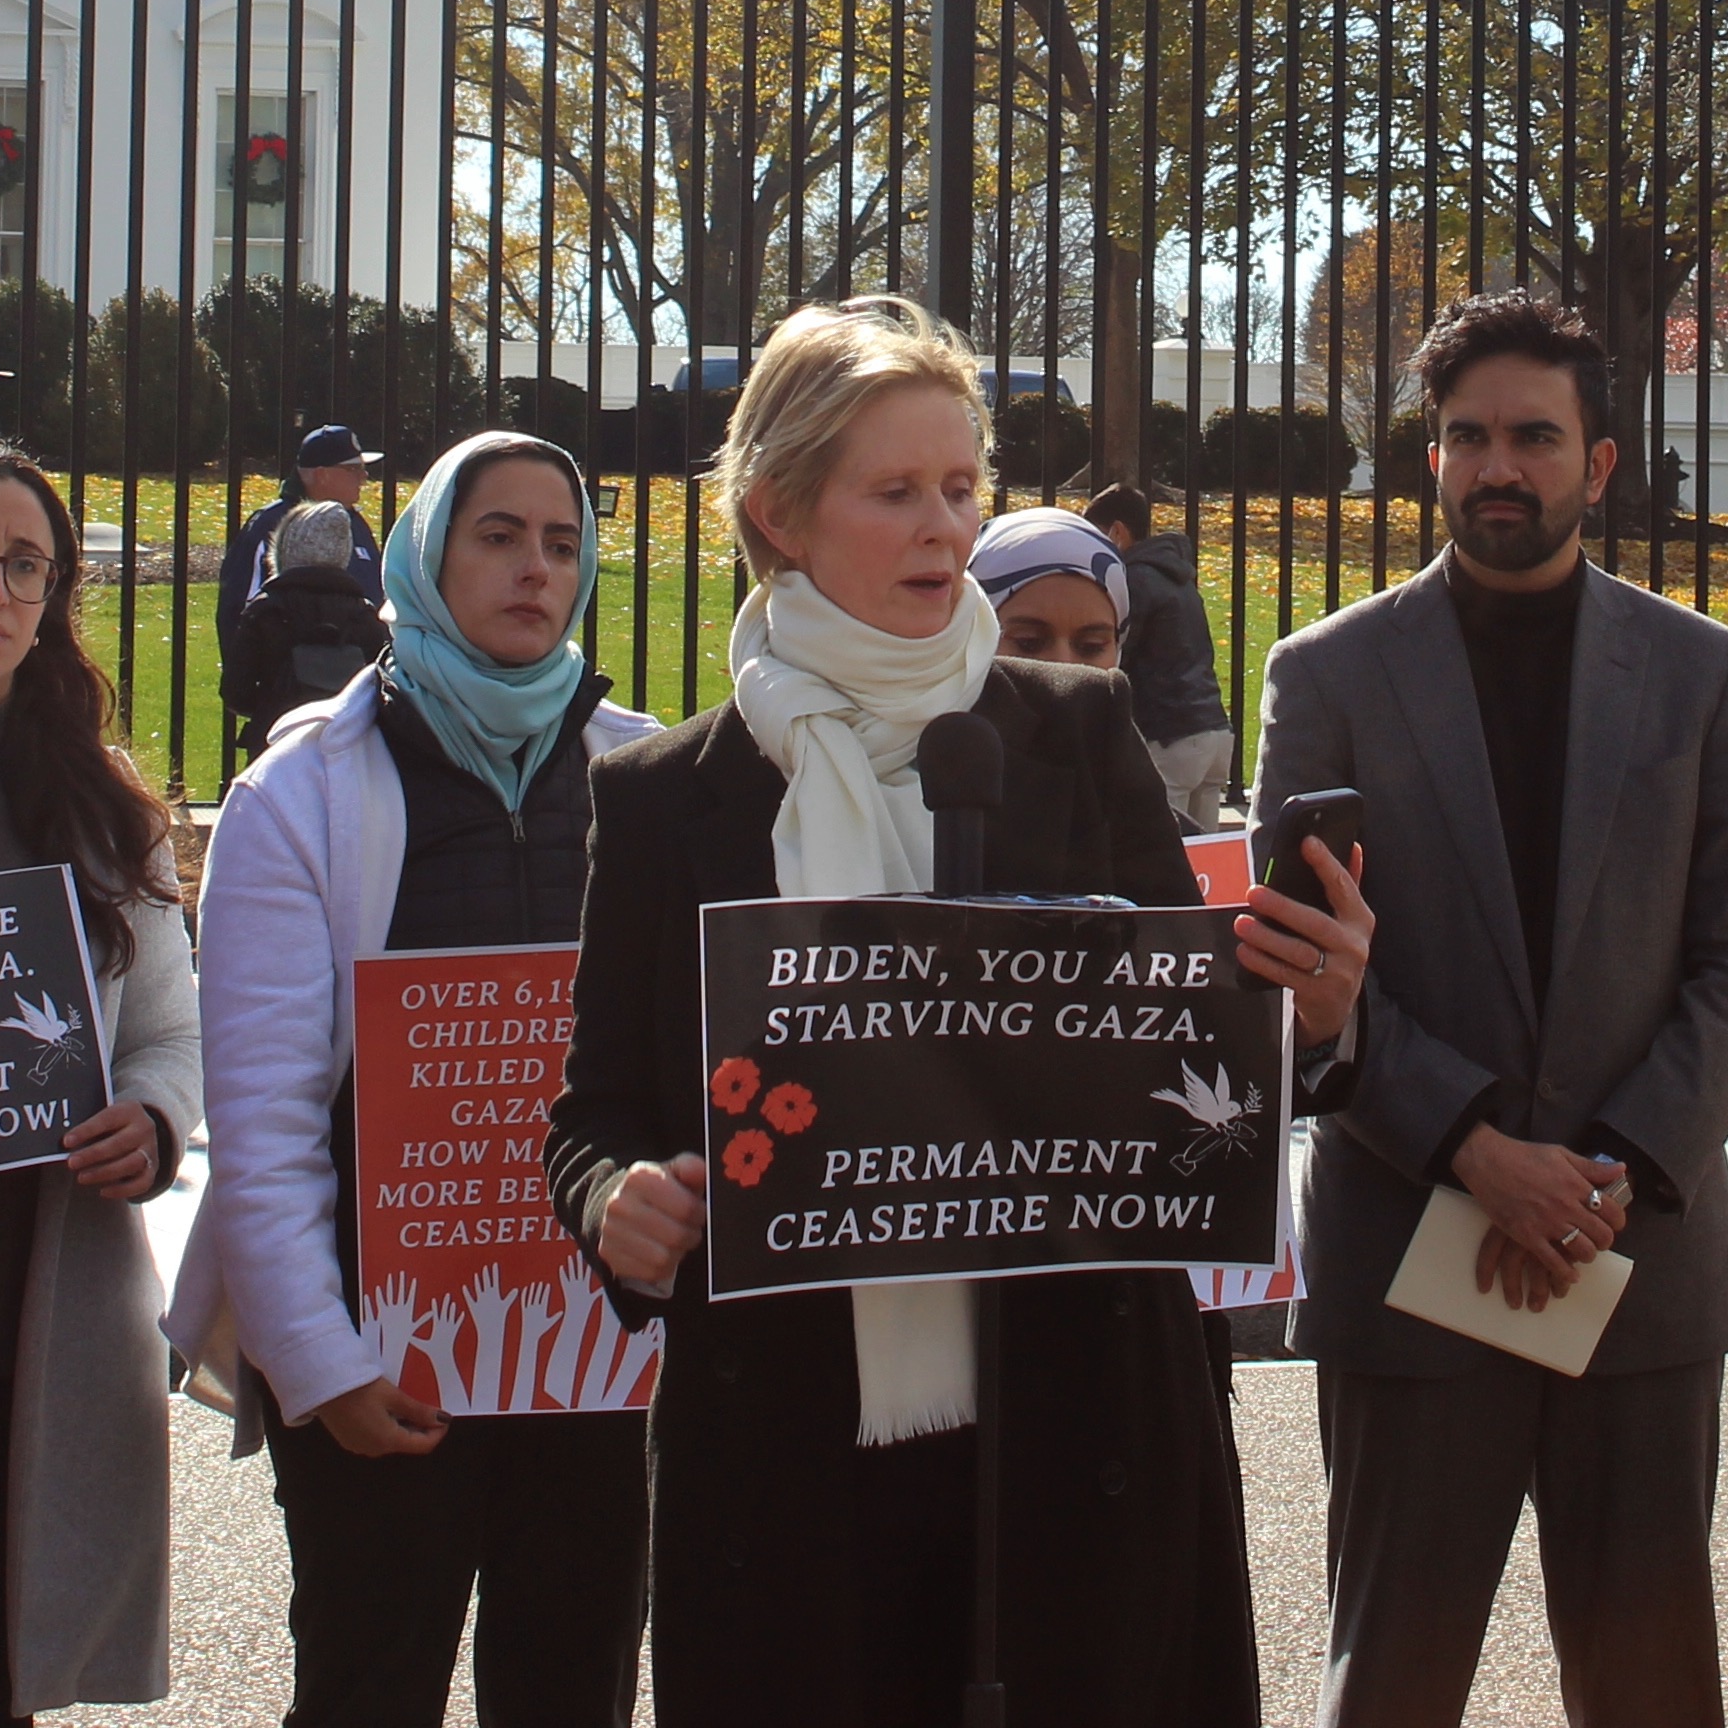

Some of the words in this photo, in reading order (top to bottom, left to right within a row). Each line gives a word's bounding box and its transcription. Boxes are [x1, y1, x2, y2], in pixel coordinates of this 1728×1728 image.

[767, 945, 950, 988] BIDEN,
[978, 949, 1088, 984] YOU
[1102, 950, 1215, 988] ARE
[400, 980, 500, 1010] OVER
[763, 1001, 1034, 1046] STARVING
[1055, 1004, 1217, 1043] GAZA.
[409, 1057, 546, 1089] KILLED
[400, 1138, 490, 1169] HOW
[821, 1138, 1158, 1190] PERMANENT
[375, 1178, 483, 1210] MORE
[765, 1194, 1050, 1252] CEASEFIRE
[1069, 1194, 1217, 1232] NOW!
